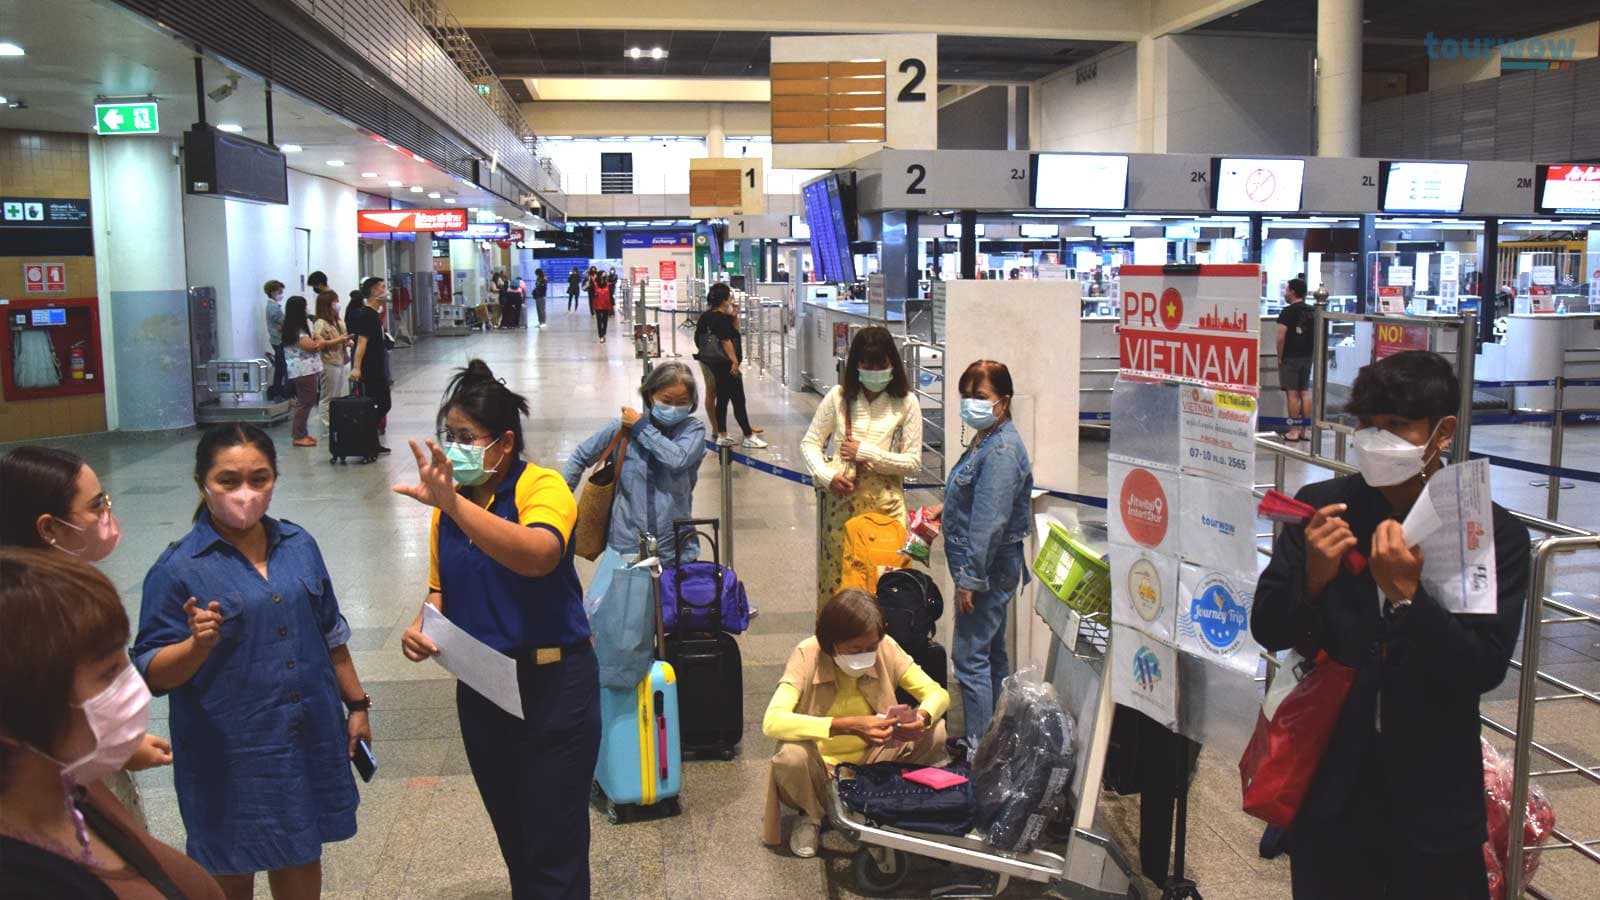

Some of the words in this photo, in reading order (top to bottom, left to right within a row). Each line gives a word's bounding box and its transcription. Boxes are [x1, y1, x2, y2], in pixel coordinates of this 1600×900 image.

[897, 58, 927, 102] 2
[745, 168, 755, 188] 1
[906, 164, 926, 194] 2
[1010, 169, 1025, 181] 2J
[1191, 171, 1206, 183] 2K
[1362, 176, 1375, 187] 2L
[1517, 177, 1532, 188] 2M
[738, 220, 745, 233] 1
[1378, 324, 1403, 343] NO!
[1125, 336, 1249, 385] VIETNAM
[1182, 402, 1214, 416] VIETNAM
[1189, 447, 1212, 461] 07-10
[1228, 456, 1247, 470] 2565
[1202, 515, 1236, 532] tourwow
[1193, 604, 1227, 625] Journey
[1228, 609, 1244, 627] Trip
